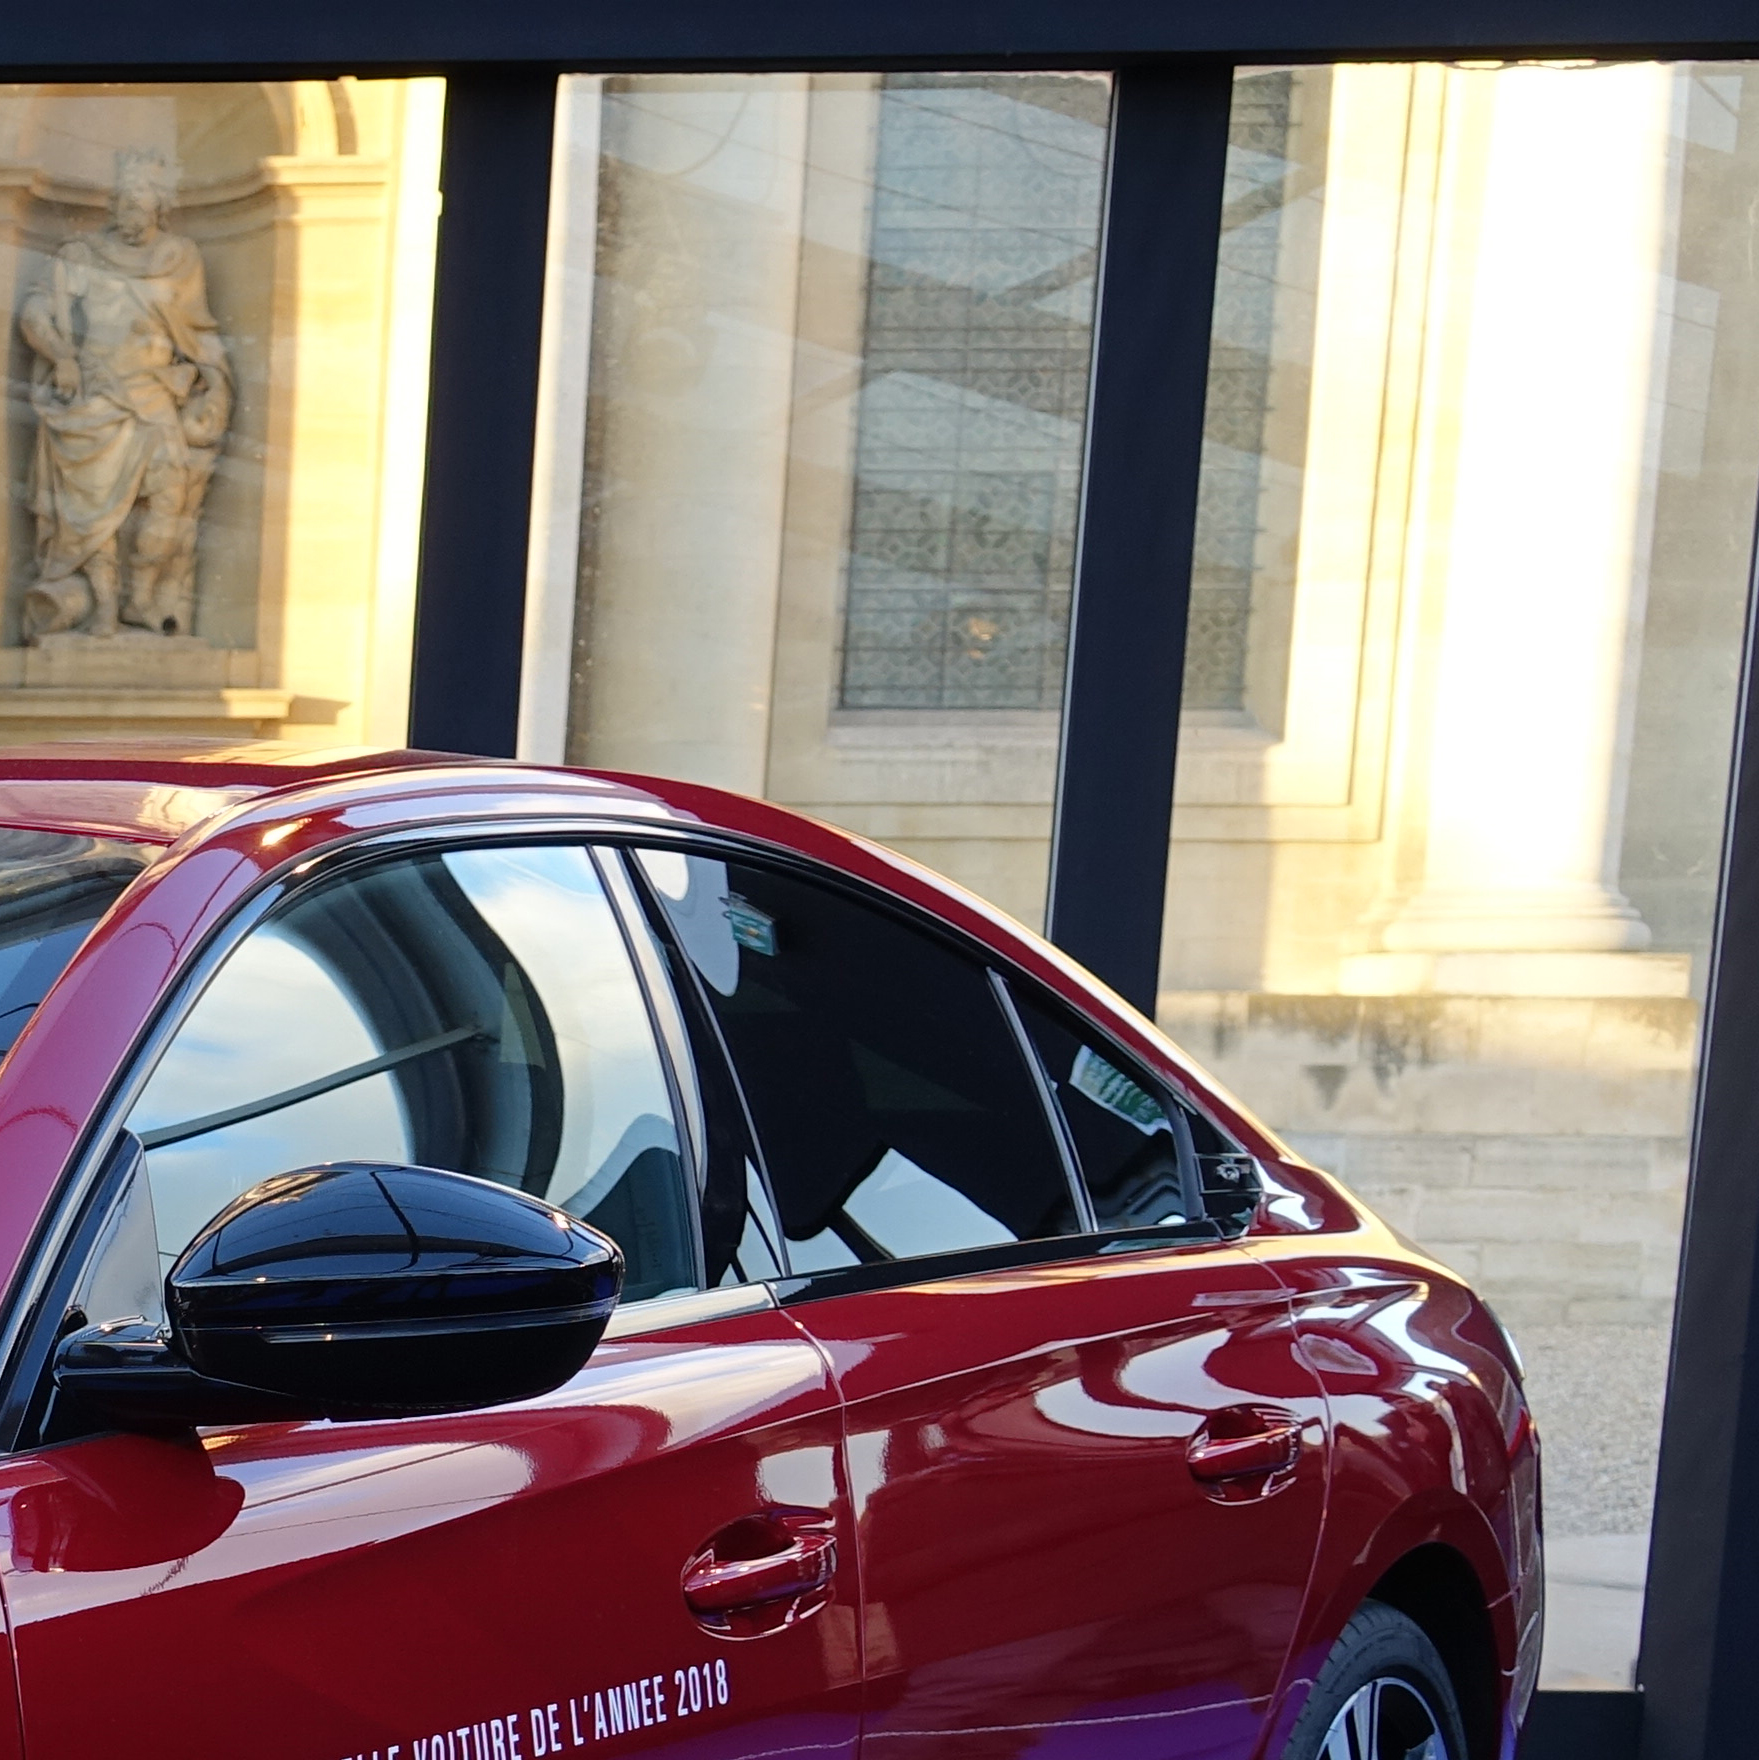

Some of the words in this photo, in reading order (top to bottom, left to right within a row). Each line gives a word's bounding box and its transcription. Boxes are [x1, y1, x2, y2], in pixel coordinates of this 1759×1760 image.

[530, 1703, 563, 1758] DE
[572, 1674, 667, 1747] L'ANNEE
[674, 1658, 729, 1718] 2018
